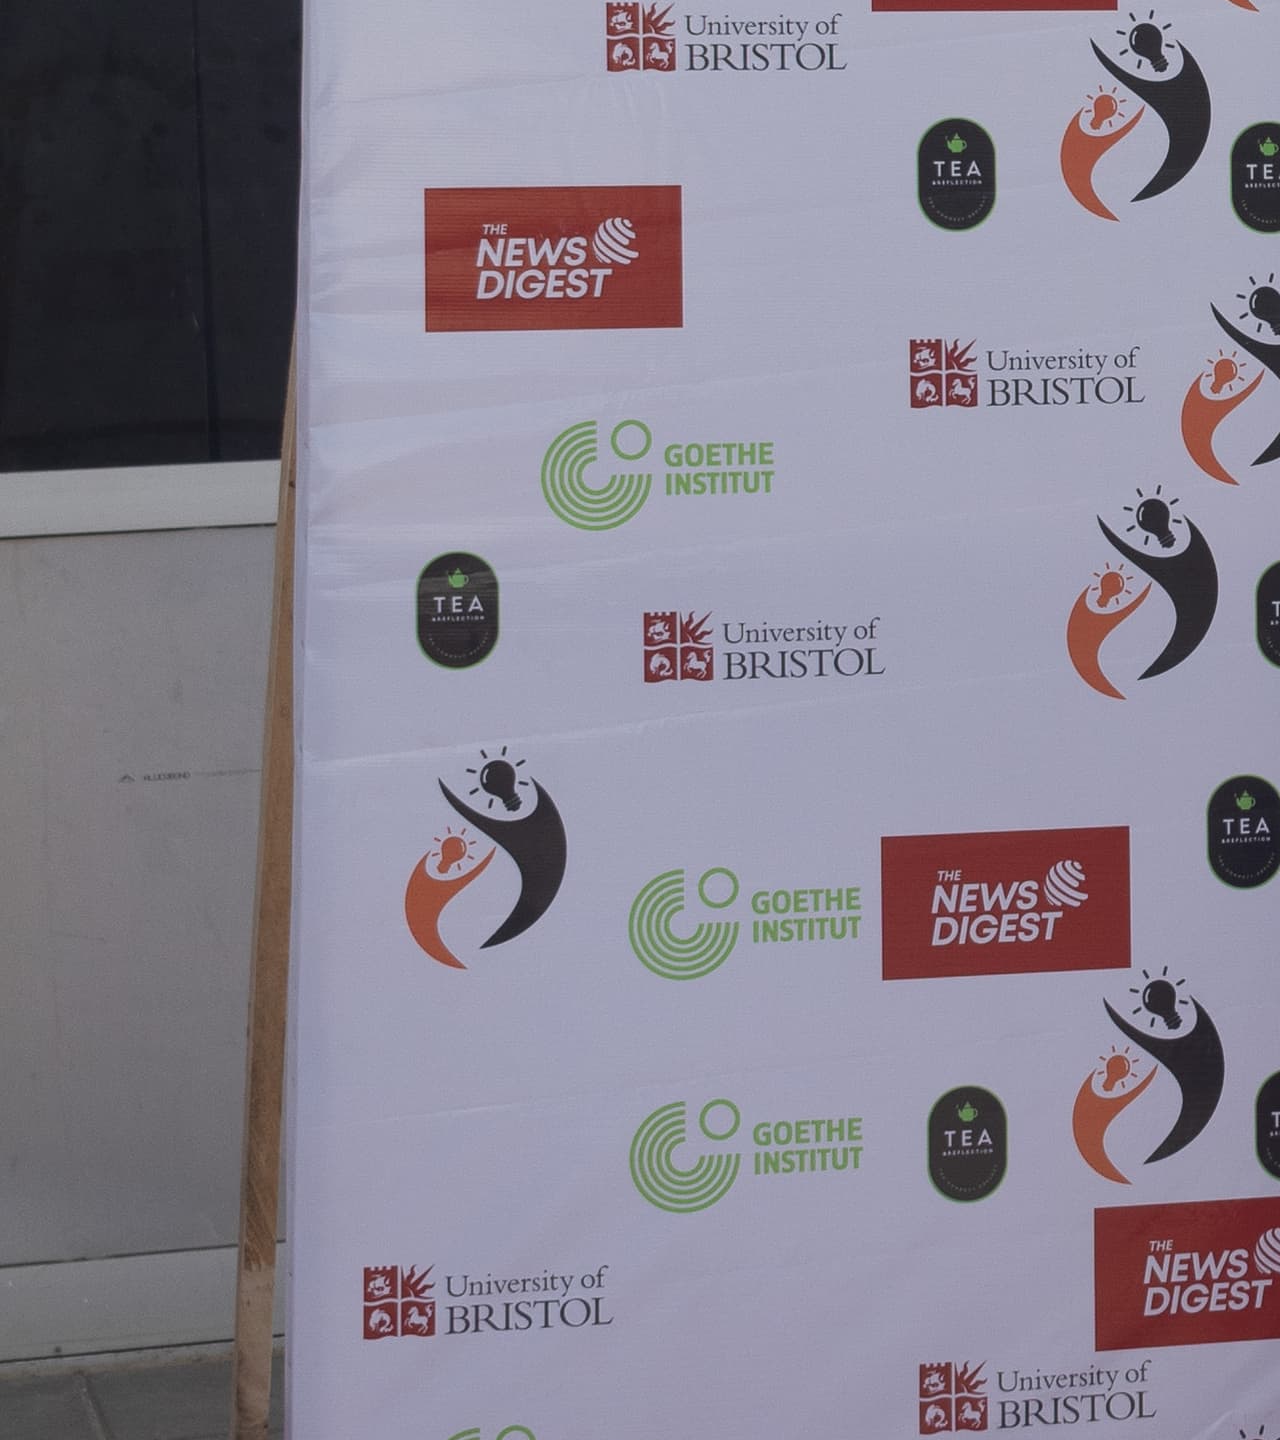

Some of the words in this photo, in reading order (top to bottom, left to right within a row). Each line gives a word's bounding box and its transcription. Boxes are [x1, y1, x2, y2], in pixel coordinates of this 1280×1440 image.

[686, 15, 808, 42] University
[816, 13, 842, 35] of
[685, 43, 847, 71] BRISTOL
[934, 161, 981, 176] TEA
[483, 224, 507, 234] THE
[476, 237, 587, 267] NEWS
[477, 269, 612, 299] DIGEST
[987, 349, 1107, 376] University
[1114, 346, 1140, 368] of
[987, 377, 1145, 406] BRISTOL
[664, 442, 774, 467] GOETHE
[666, 470, 775, 496] INSTITUT
[433, 595, 483, 613] TEA
[1223, 818, 1269, 835] TEA
[938, 870, 961, 881] THE
[751, 887, 861, 915] GOETHE
[932, 881, 1039, 913] NEWS
[753, 916, 861, 943] INSTITUT
[932, 912, 1063, 945] DIGEST
[944, 1129, 992, 1147] TEA
[1150, 1240, 1173, 1251] THE
[1144, 1249, 1248, 1284] NEWS
[446, 1270, 573, 1299] University
[581, 1265, 608, 1288] of
[1144, 1280, 1272, 1316] DIGEST
[445, 1296, 613, 1335] BRISTOL
